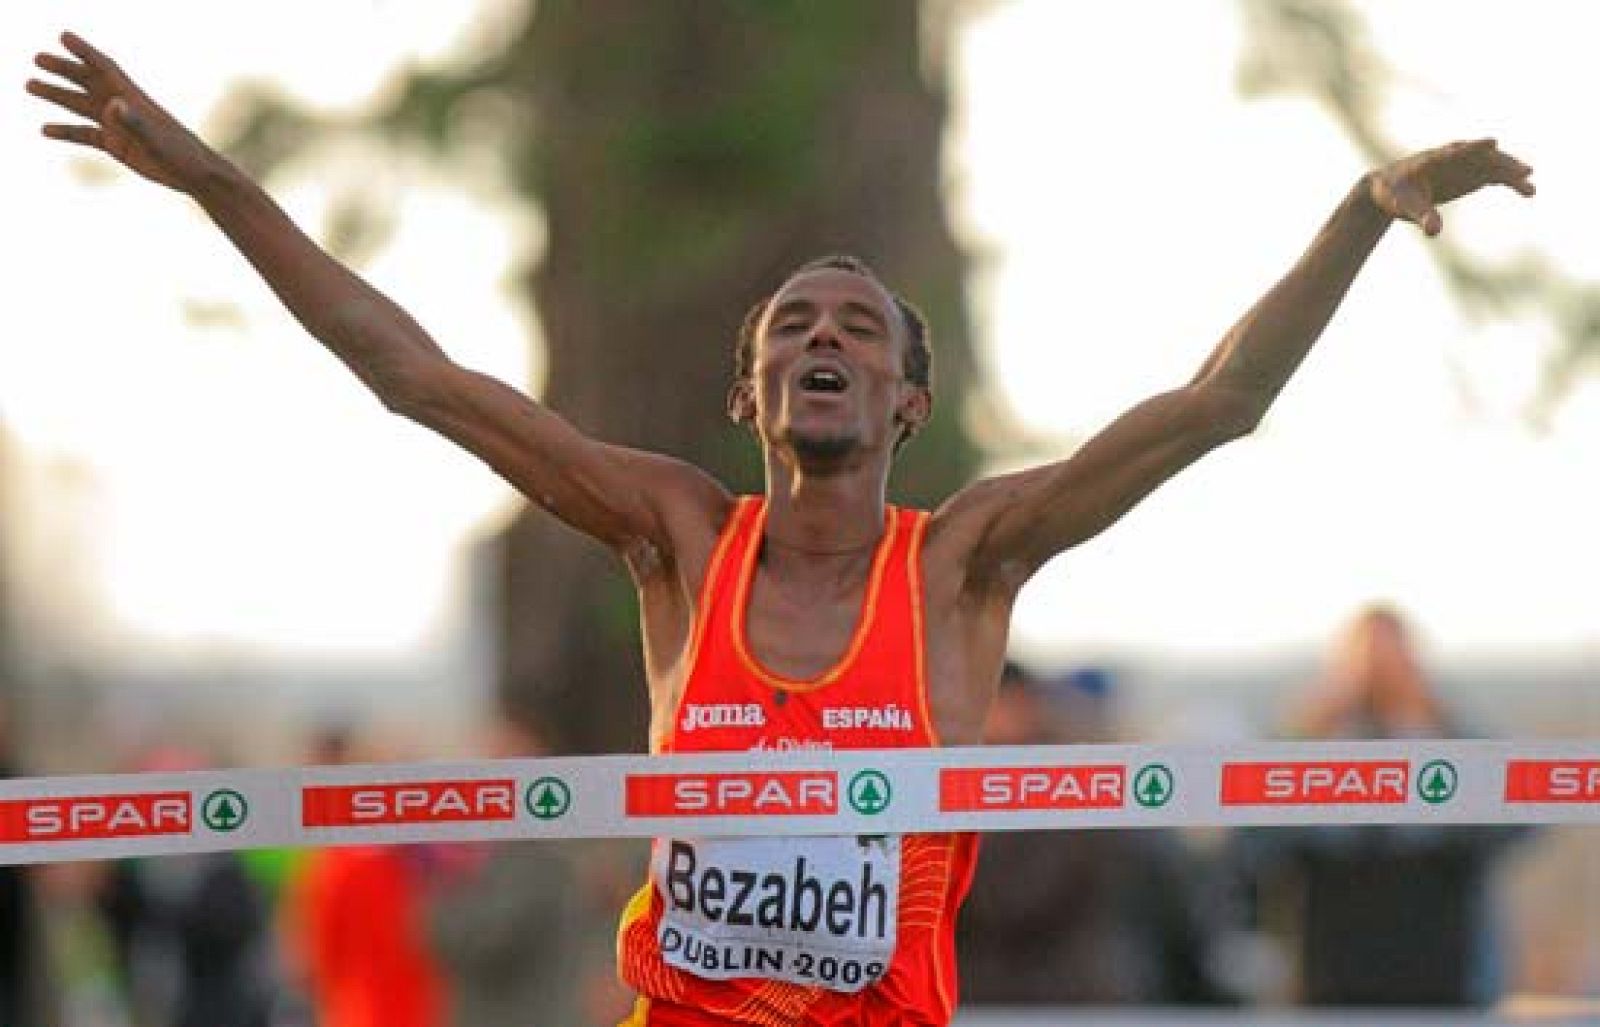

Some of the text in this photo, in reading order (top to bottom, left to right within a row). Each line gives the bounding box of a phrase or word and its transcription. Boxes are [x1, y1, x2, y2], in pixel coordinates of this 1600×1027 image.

[822, 703, 912, 730] ESPAÑA
[26, 799, 188, 834] SPAR
[351, 785, 511, 824] SPAR
[674, 777, 834, 809] SPAR
[982, 772, 1122, 804] SPAR
[1264, 767, 1406, 799] SPAR
[667, 839, 887, 938] Bezabeh
[661, 926, 784, 971] DUBLIN
